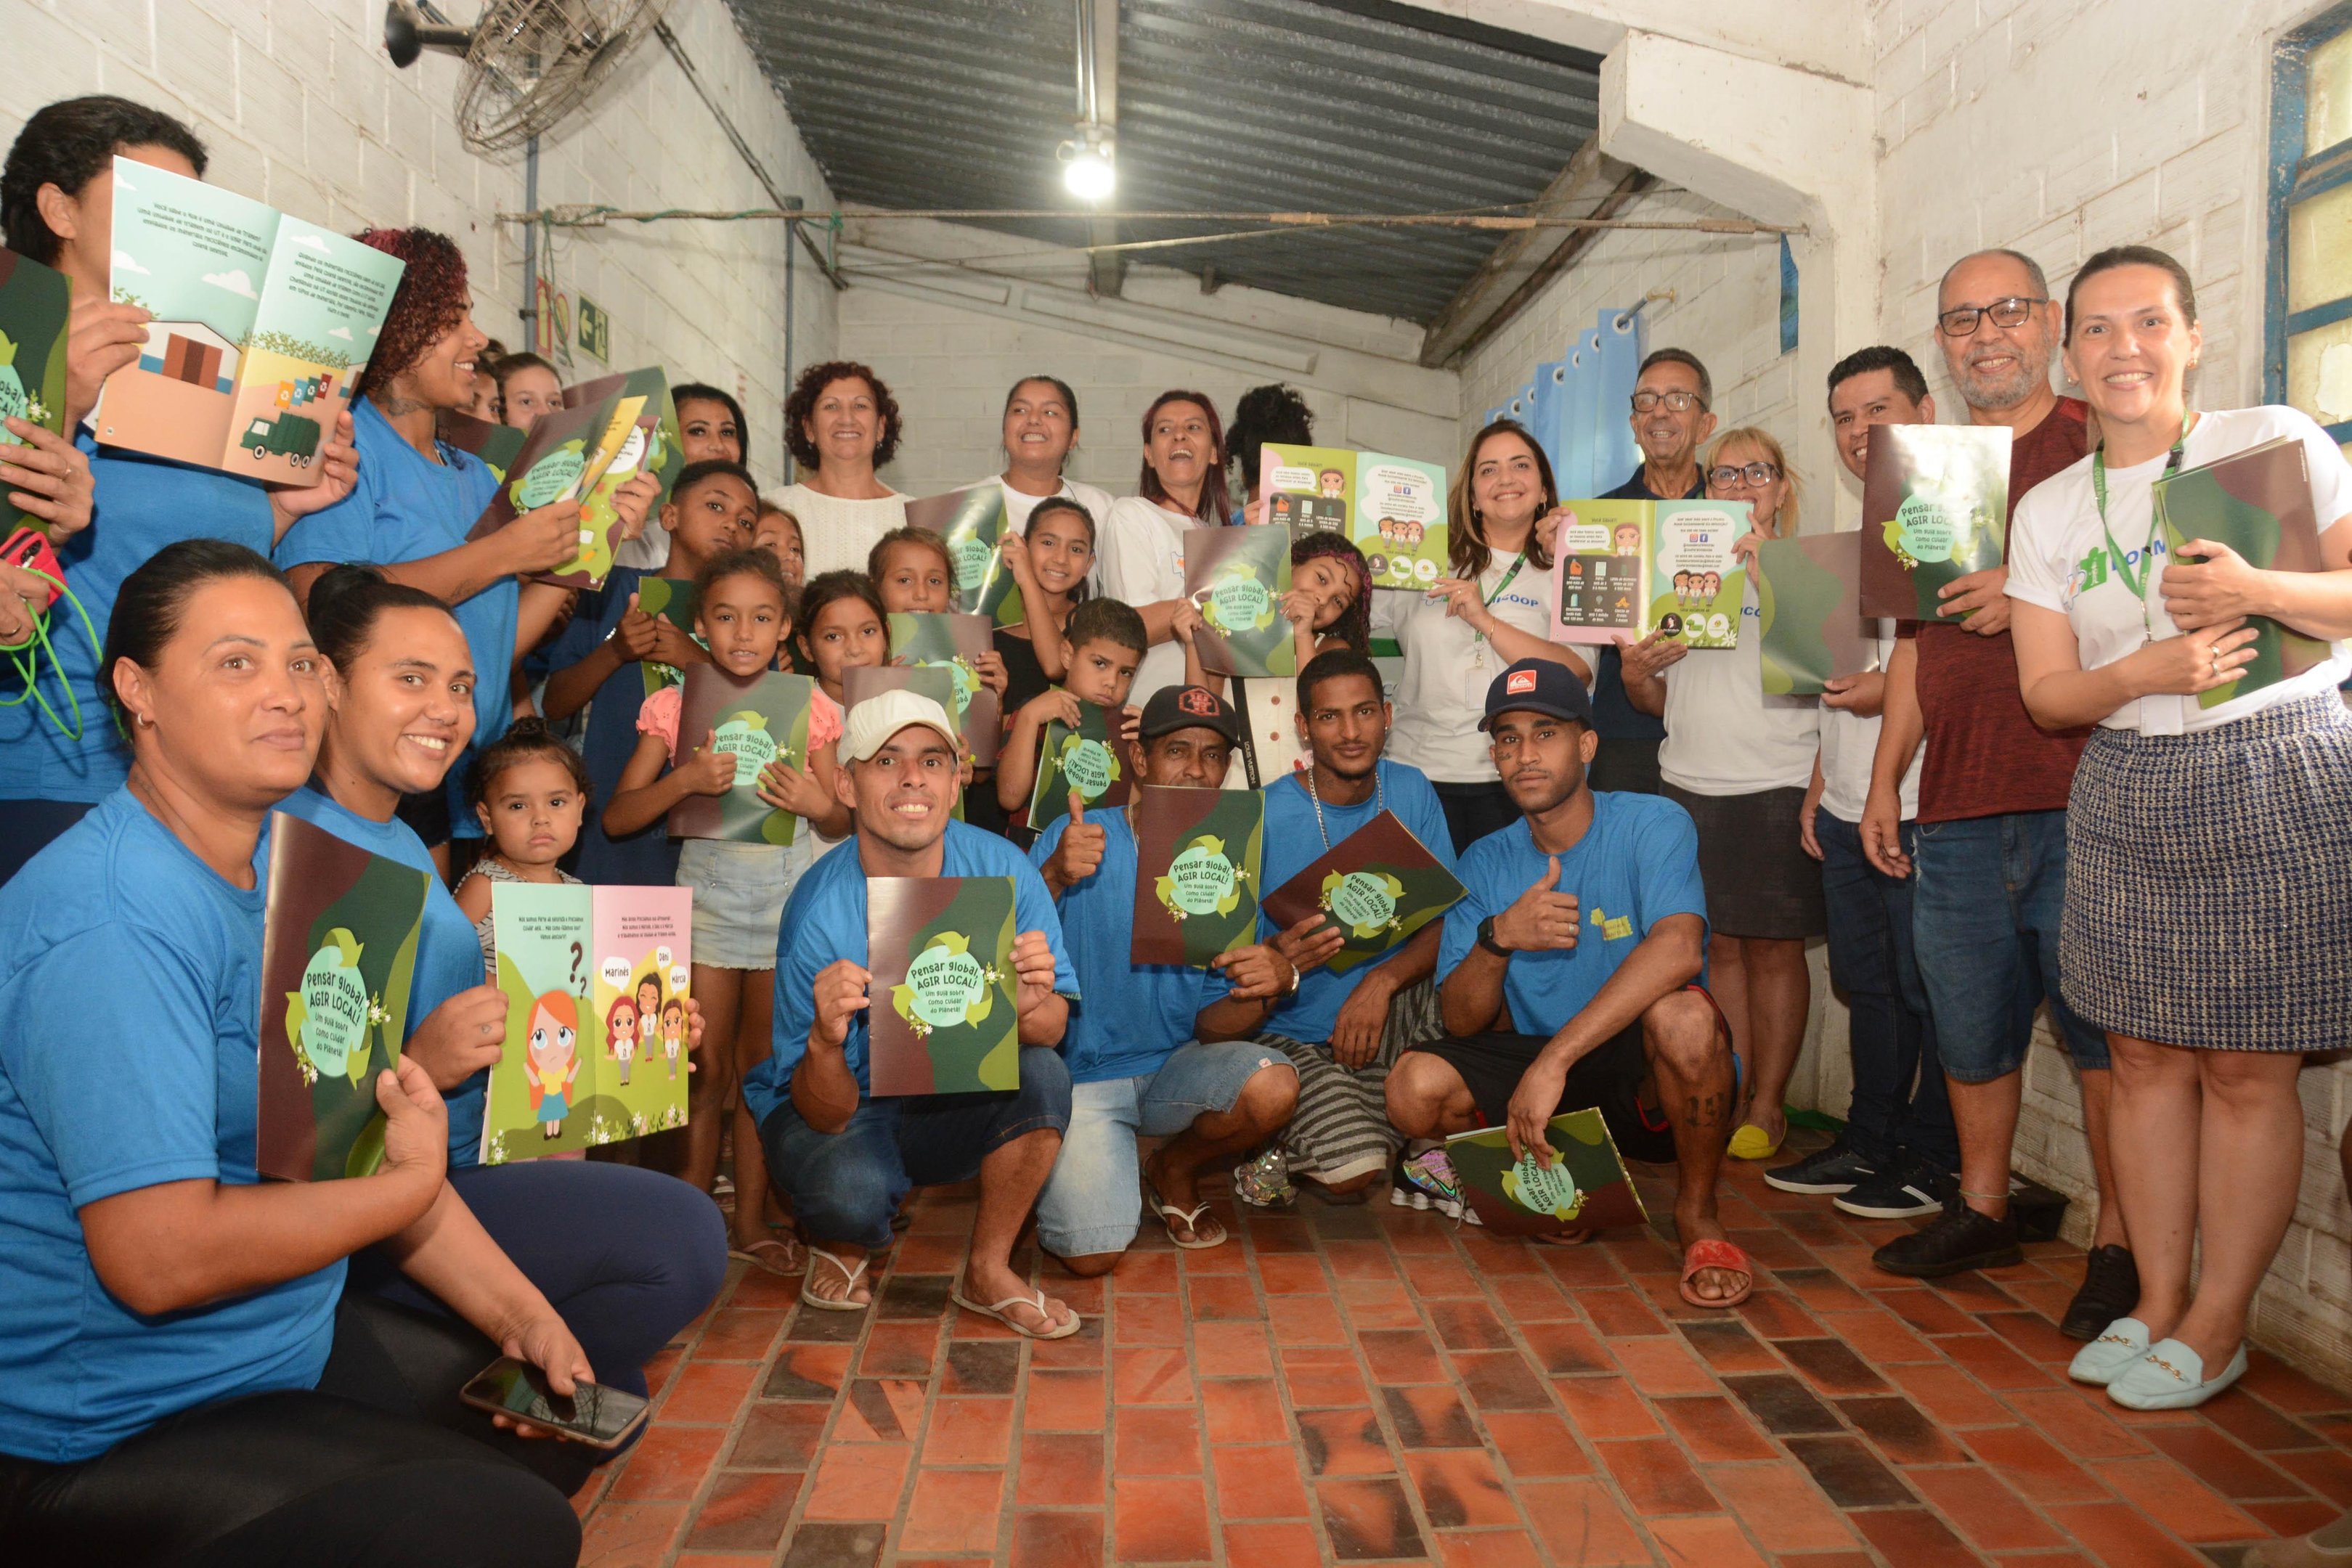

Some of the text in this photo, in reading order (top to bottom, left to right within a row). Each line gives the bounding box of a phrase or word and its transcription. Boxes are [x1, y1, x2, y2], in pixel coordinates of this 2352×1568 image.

[1901, 503, 1934, 517] Pensar
[1906, 515, 1928, 527] AGIR
[717, 743, 770, 760] AGIR LOCAL!
[746, 735, 773, 752] global,
[1066, 766, 1084, 783] global,
[1068, 759, 1089, 775] LOCAL!
[1173, 860, 1230, 876] Pensar global,
[1178, 871, 1229, 885] AGIR LOCAL!
[1346, 883, 1383, 920] AGIR LOCAL!
[1351, 875, 1391, 917] Pensar global,
[659, 952, 670, 962] Dani
[911, 961, 980, 979] Pensar global,
[917, 974, 977, 991] AGIR LOCAL!
[307, 972, 365, 1012] Pensar global,
[309, 992, 361, 1026] AGIR LOCAL!
[314, 1013, 349, 1033] Um guia sobre
[317, 1042, 323, 1051] do
[1526, 1188, 1547, 1212] Pensar
[1537, 1188, 1554, 1206] AGIR
